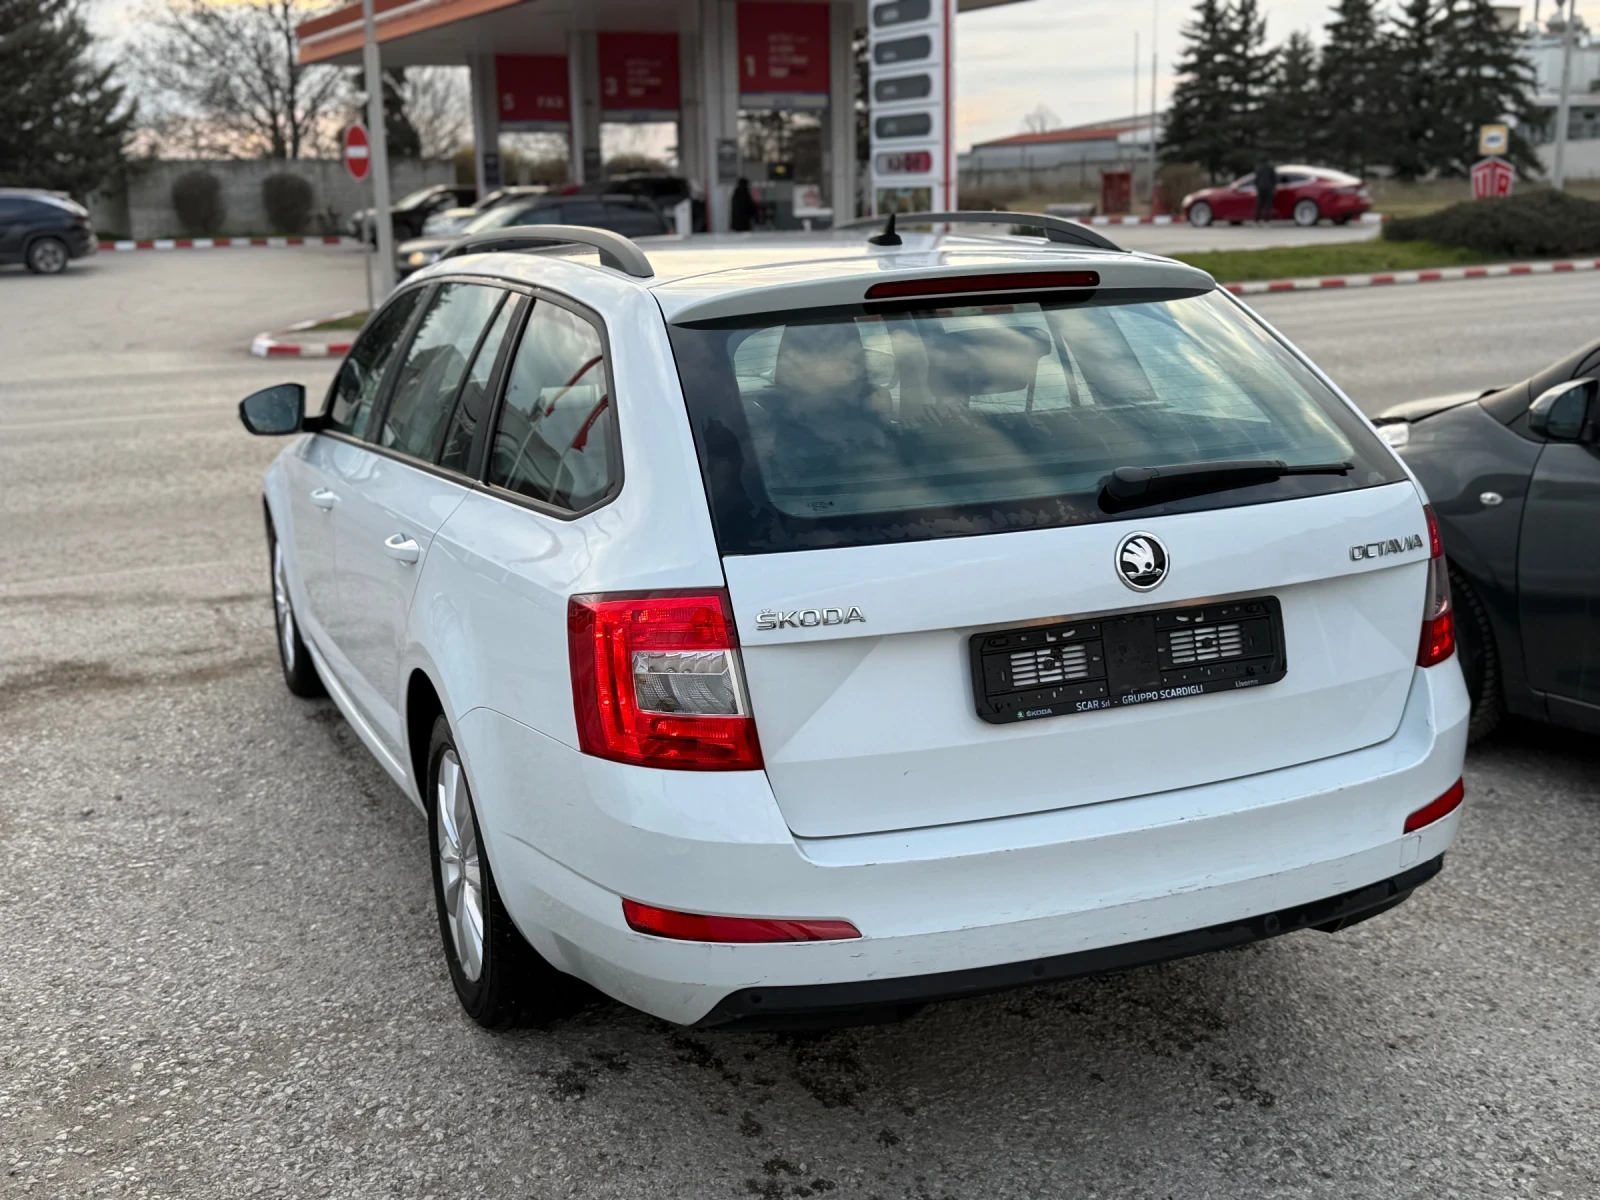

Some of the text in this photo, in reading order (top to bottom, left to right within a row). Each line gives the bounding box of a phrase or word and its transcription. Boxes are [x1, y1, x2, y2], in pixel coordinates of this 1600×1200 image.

[1349, 533, 1423, 561] OCTAVIA
[756, 606, 867, 631] ŠKODA
[1076, 700, 1100, 711] SCAR
[1101, 700, 1111, 708] Srl
[1122, 691, 1158, 704] GRUPPO
[1159, 684, 1204, 699] SCARDIGLI
